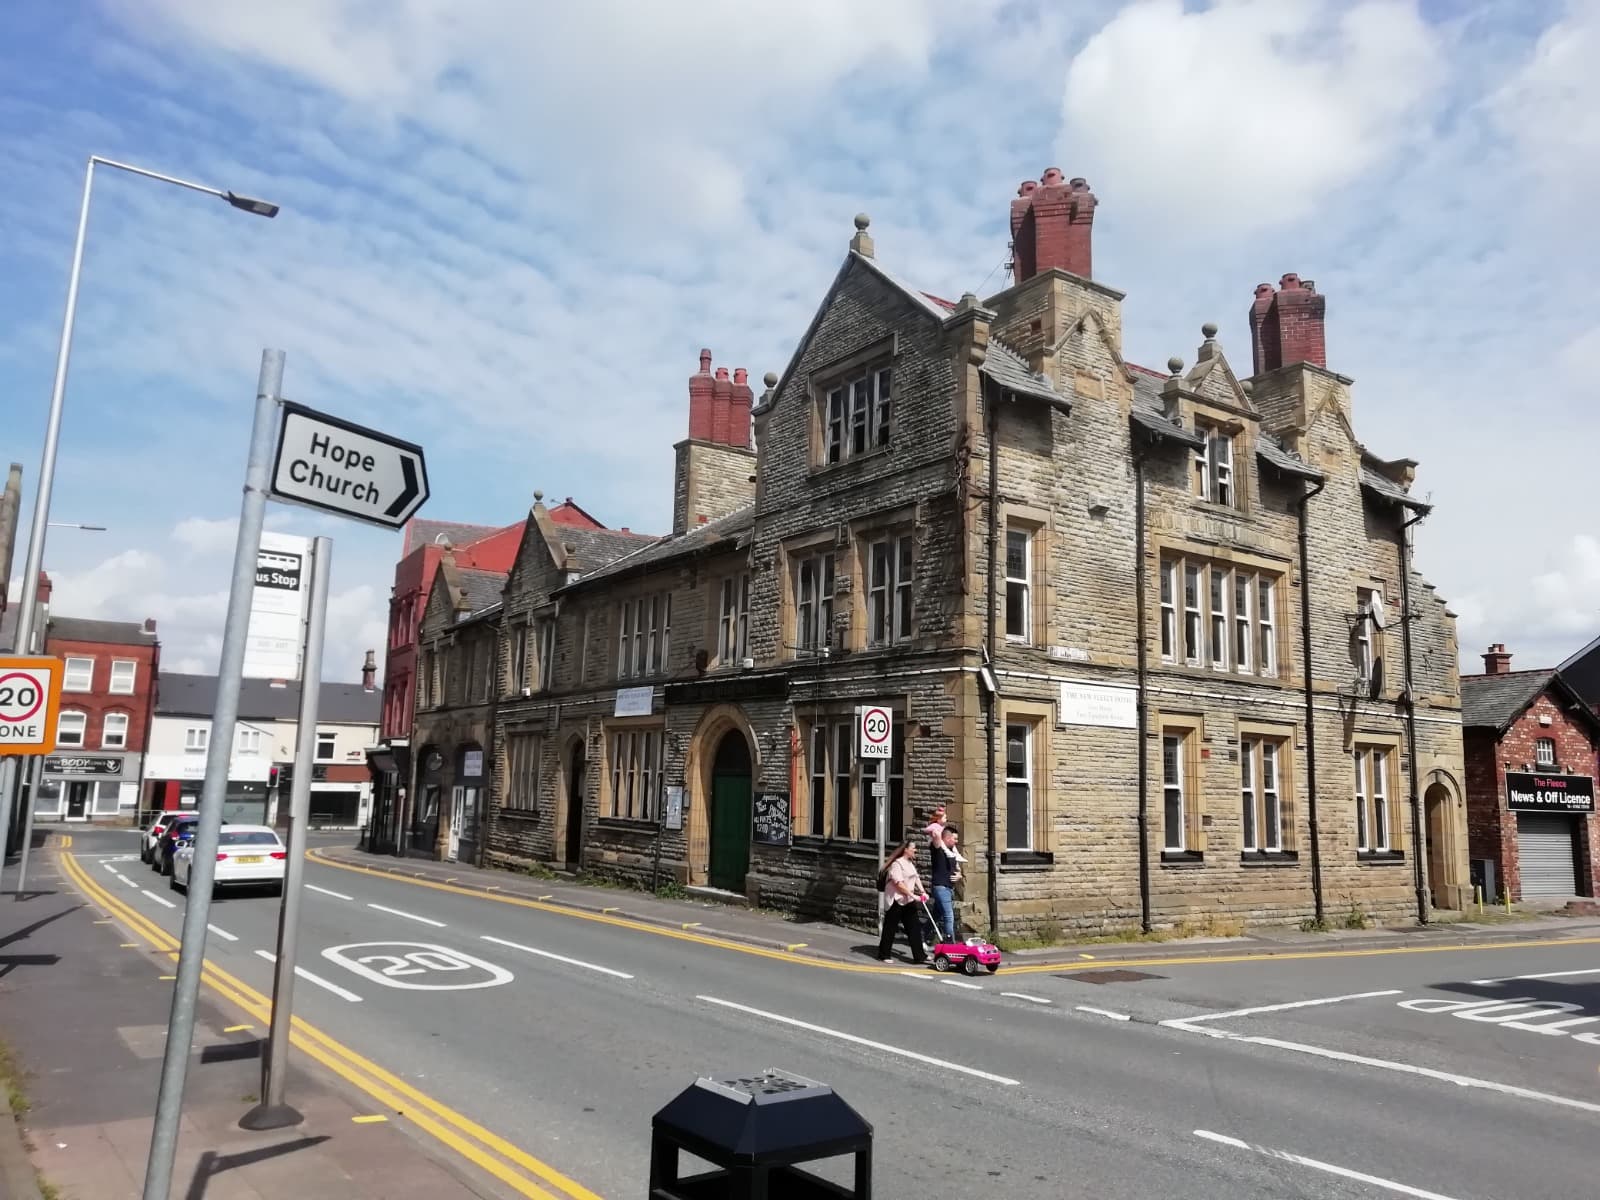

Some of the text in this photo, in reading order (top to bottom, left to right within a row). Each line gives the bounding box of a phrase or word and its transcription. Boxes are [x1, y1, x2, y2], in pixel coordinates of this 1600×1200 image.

[310, 432, 375, 472] Hope
[290, 459, 380, 505] Church
[256, 573, 297, 588] us Stop
[0, 687, 36, 707] 20
[0, 725, 37, 738] ONE
[867, 718, 887, 733] 20
[864, 744, 889, 755] ZONE
[61, 758, 90, 767] BODY
[1534, 778, 1567, 788] The Fleece
[1511, 790, 1591, 804] News & Off Licence
[357, 952, 471, 976] 20
[1396, 997, 1600, 1045] TOP
